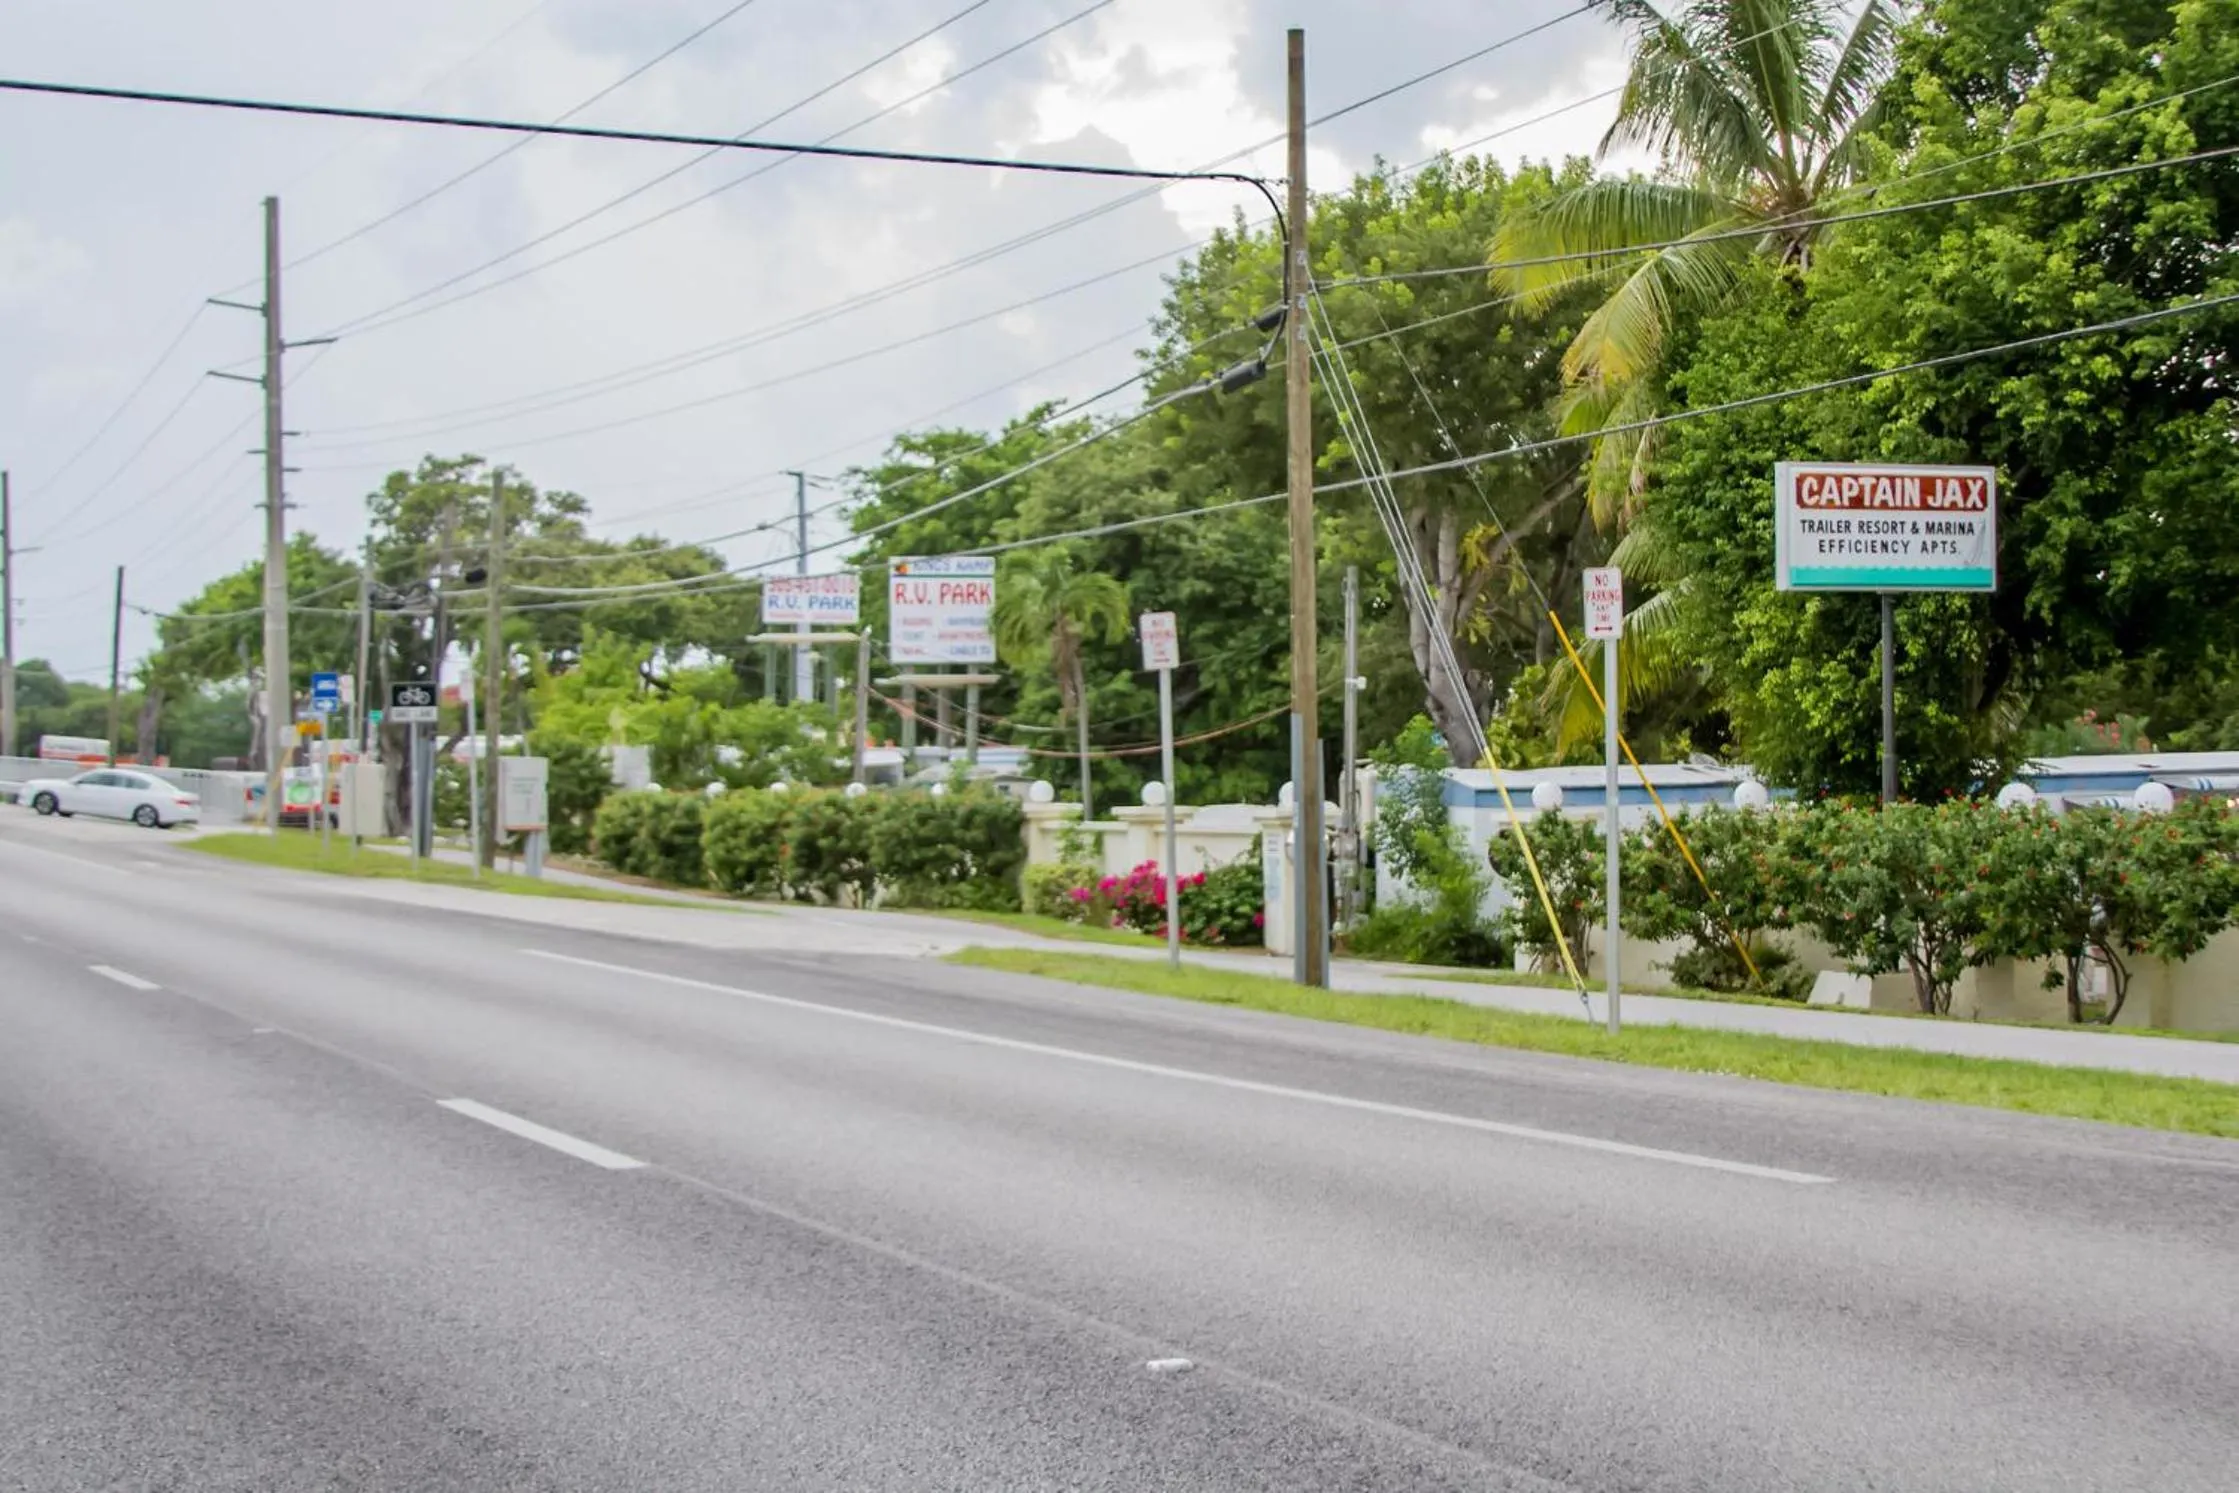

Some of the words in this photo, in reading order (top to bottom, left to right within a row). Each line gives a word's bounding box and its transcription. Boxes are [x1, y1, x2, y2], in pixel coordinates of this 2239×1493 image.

[1801, 476, 1921, 508] CAPTAIN
[1927, 478, 1984, 509] JAX
[1800, 519, 1852, 534] TRAILER
[1858, 520, 1907, 535] RESORT
[1911, 521, 1920, 535] &
[1925, 521, 1975, 536] MARINA
[1818, 539, 1911, 554] EFFICIENCY
[1595, 574, 1608, 586] NO
[895, 582, 932, 605] R.V.
[938, 582, 992, 605] PARK
[1586, 590, 1619, 602] PARKING
[808, 594, 857, 610] PARK
